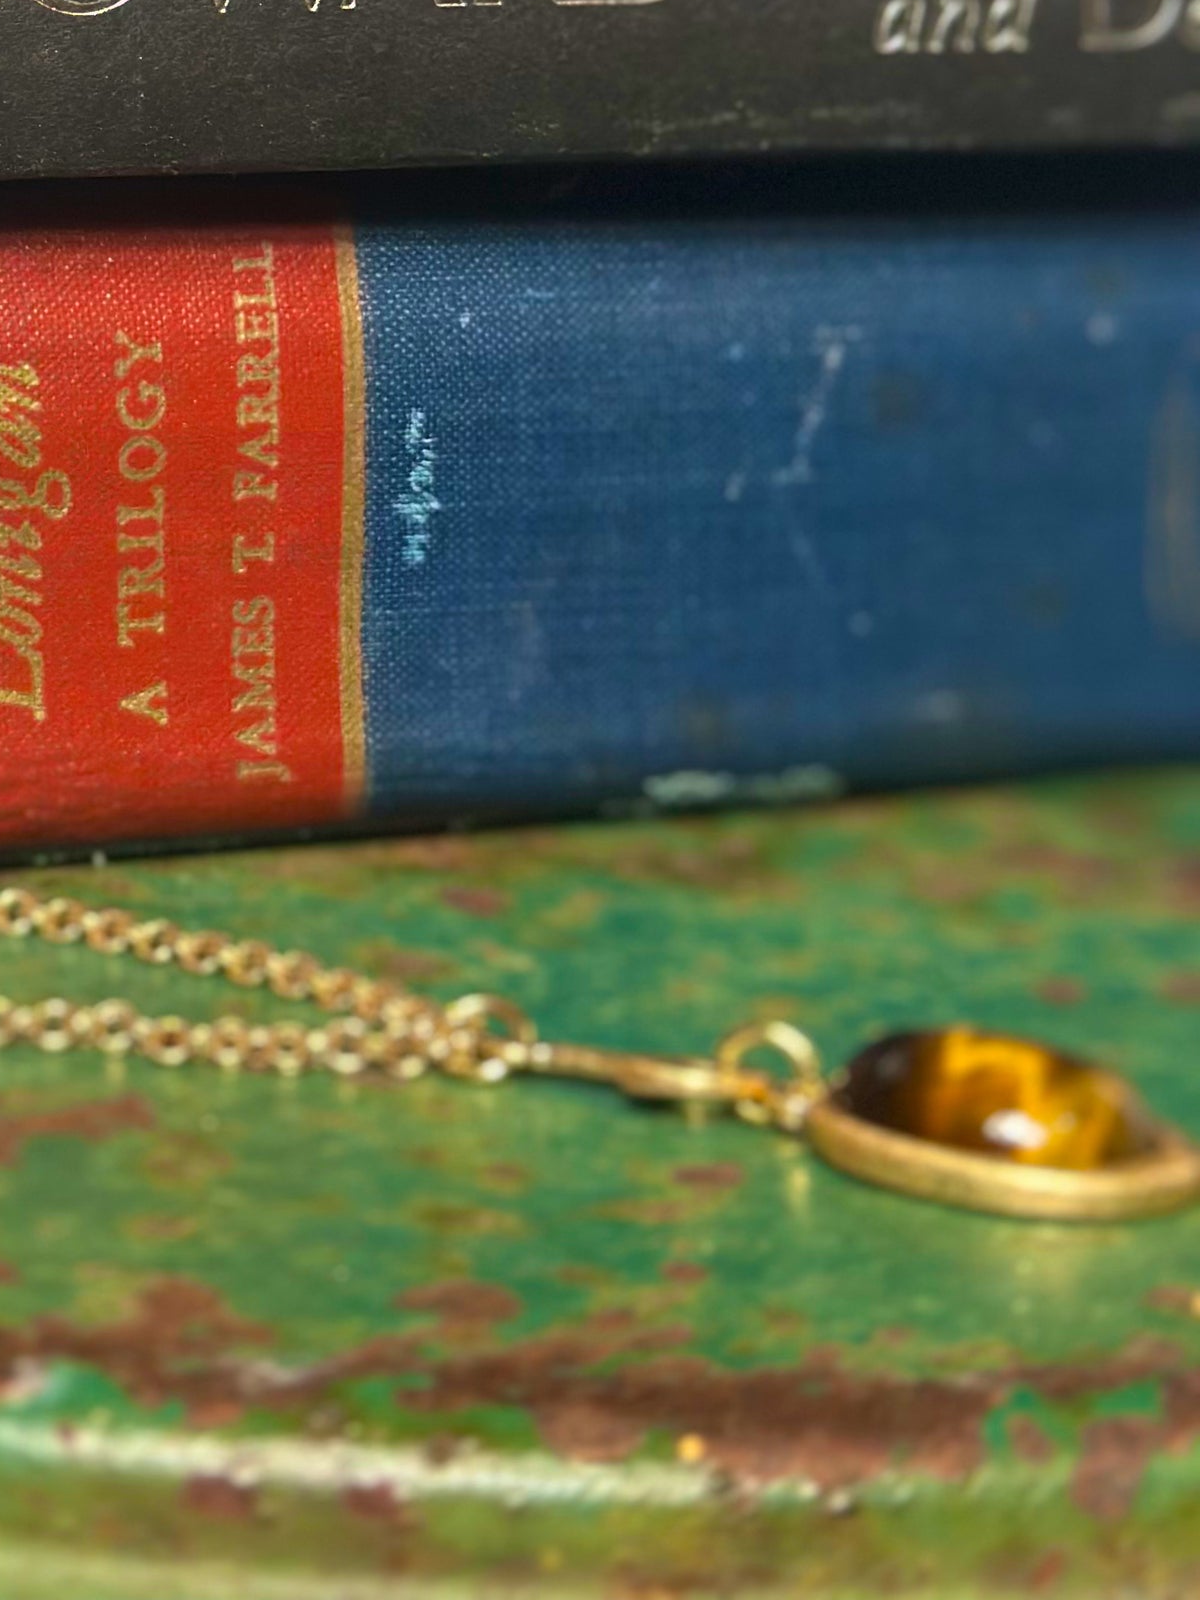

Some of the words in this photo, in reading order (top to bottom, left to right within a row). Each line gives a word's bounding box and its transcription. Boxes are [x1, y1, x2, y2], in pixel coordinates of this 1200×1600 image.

[232, 240, 281, 501] FARRELL
[114, 328, 167, 648] TRILOGY
[119, 680, 168, 726] A
[231, 594, 290, 782] JAMES
